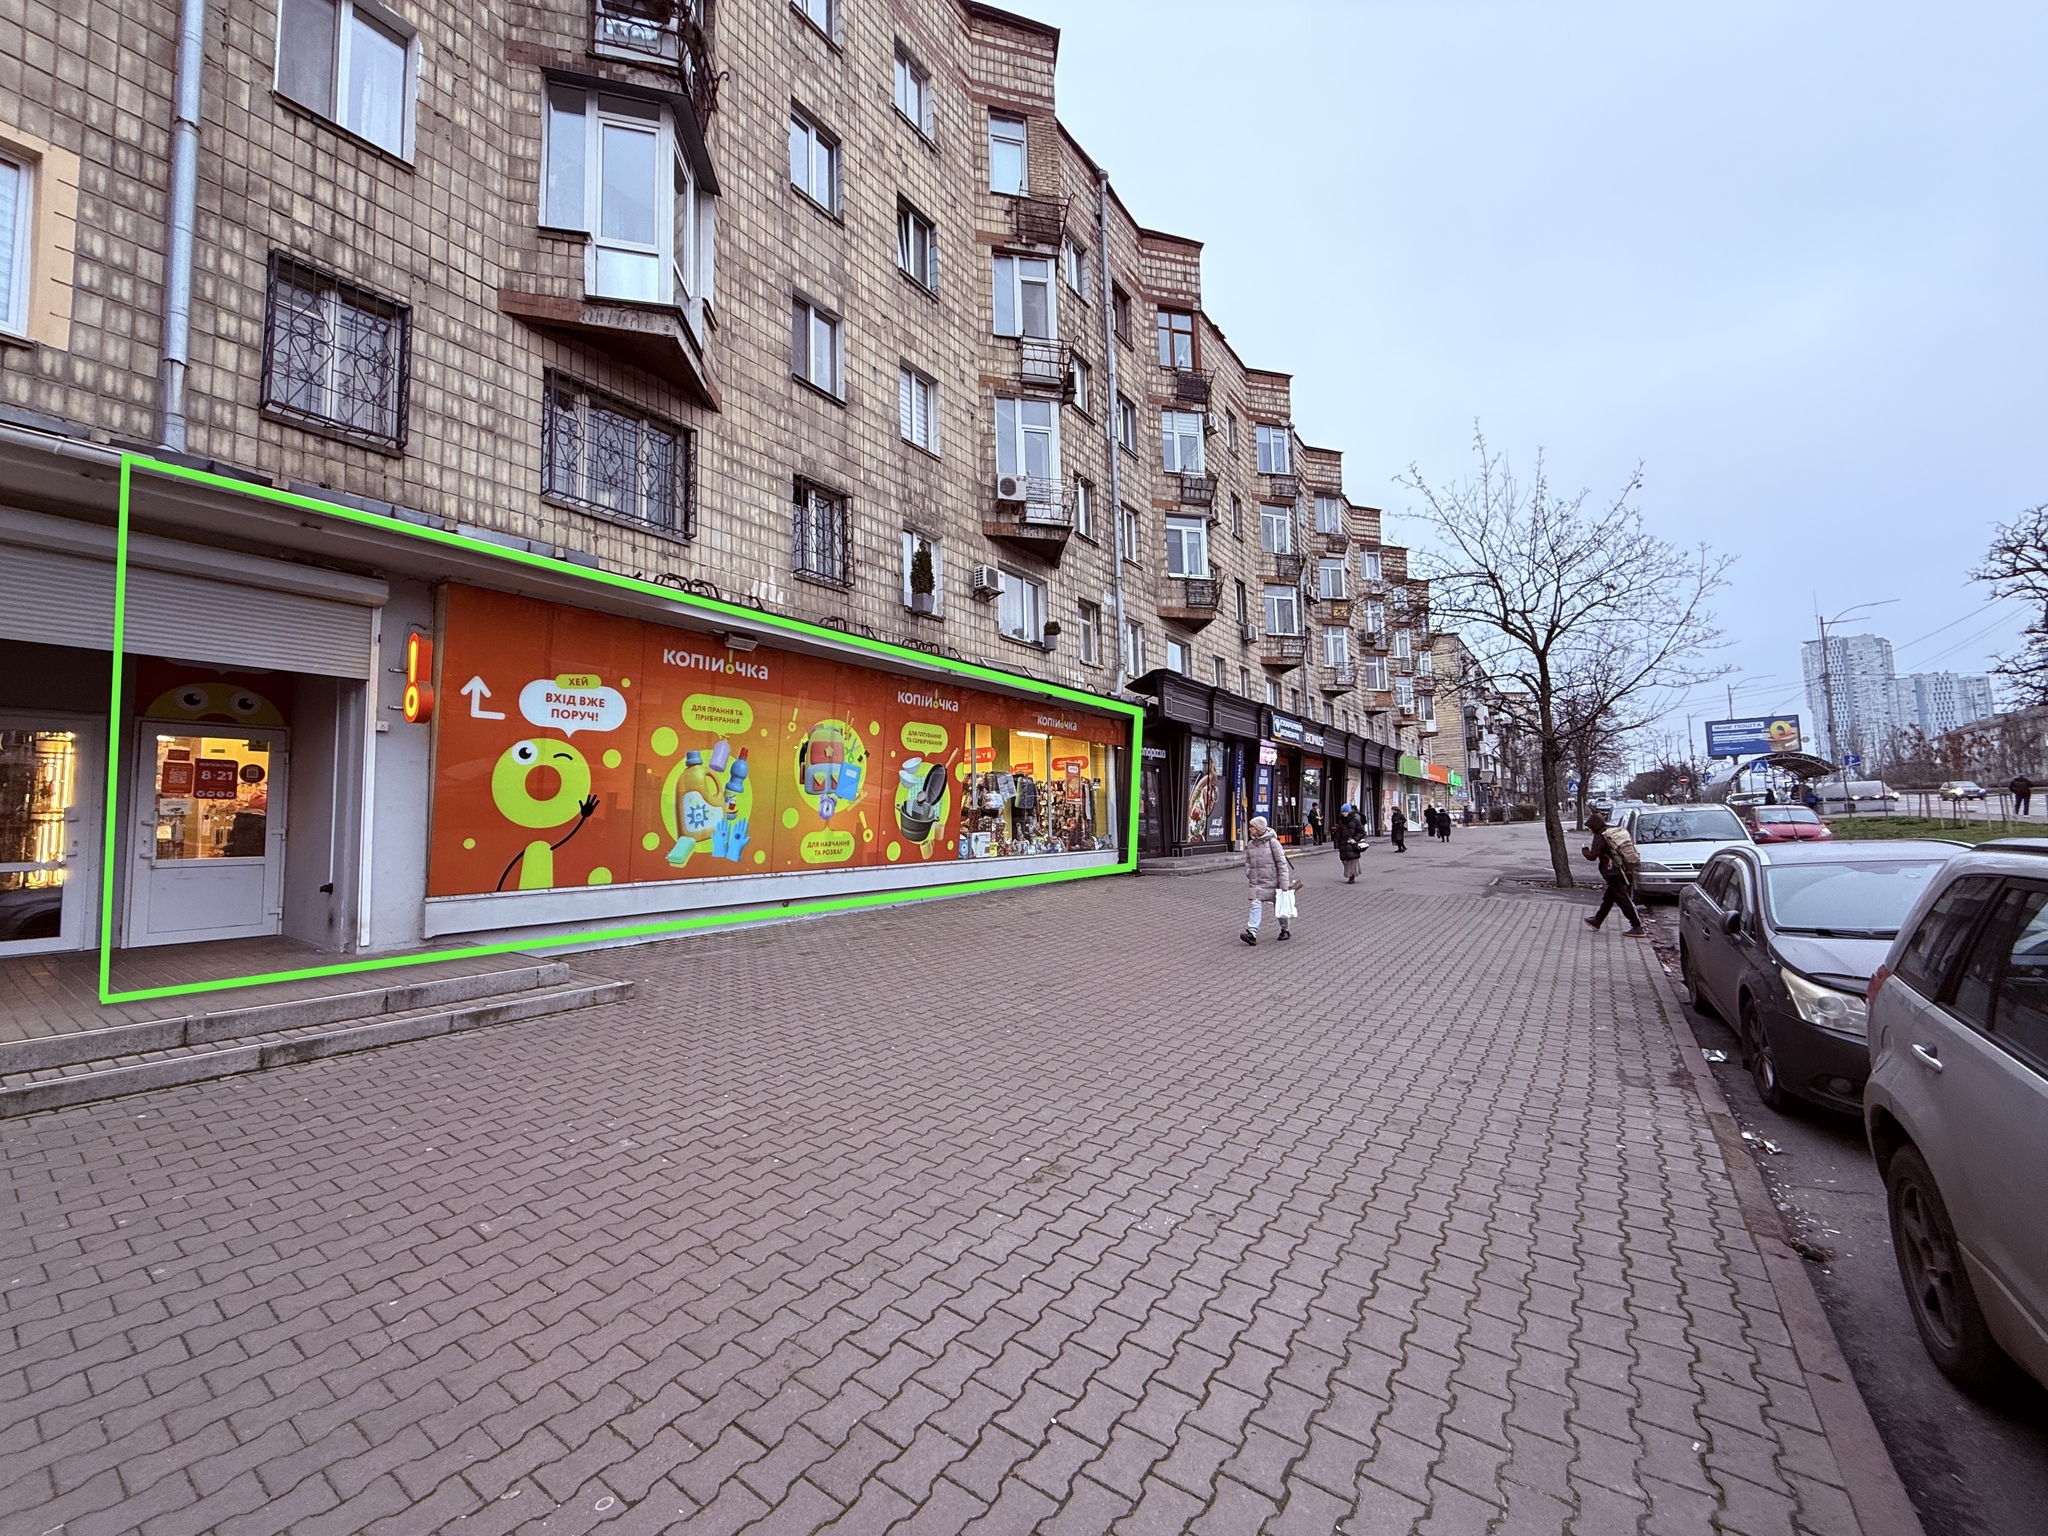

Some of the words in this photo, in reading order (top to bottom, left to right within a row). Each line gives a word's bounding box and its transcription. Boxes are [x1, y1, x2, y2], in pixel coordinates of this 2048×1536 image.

[568, 676, 589, 686] ХЕЙ
[545, 692, 577, 706] ВХІД
[579, 696, 606, 708] ВЖЕ
[551, 708, 599, 722] ПОРУЧ!
[691, 704, 706, 712] ДЛЯ
[707, 706, 734, 716] ПРАННЯ
[734, 709, 744, 717] ТА
[695, 714, 740, 724] ПРИБИРАННЯ
[1305, 732, 1324, 747] BONUS
[806, 841, 819, 849] ДЛЯ
[820, 840, 850, 848] НАВЧАННЯ
[822, 848, 843, 856] РОЗВАГ
